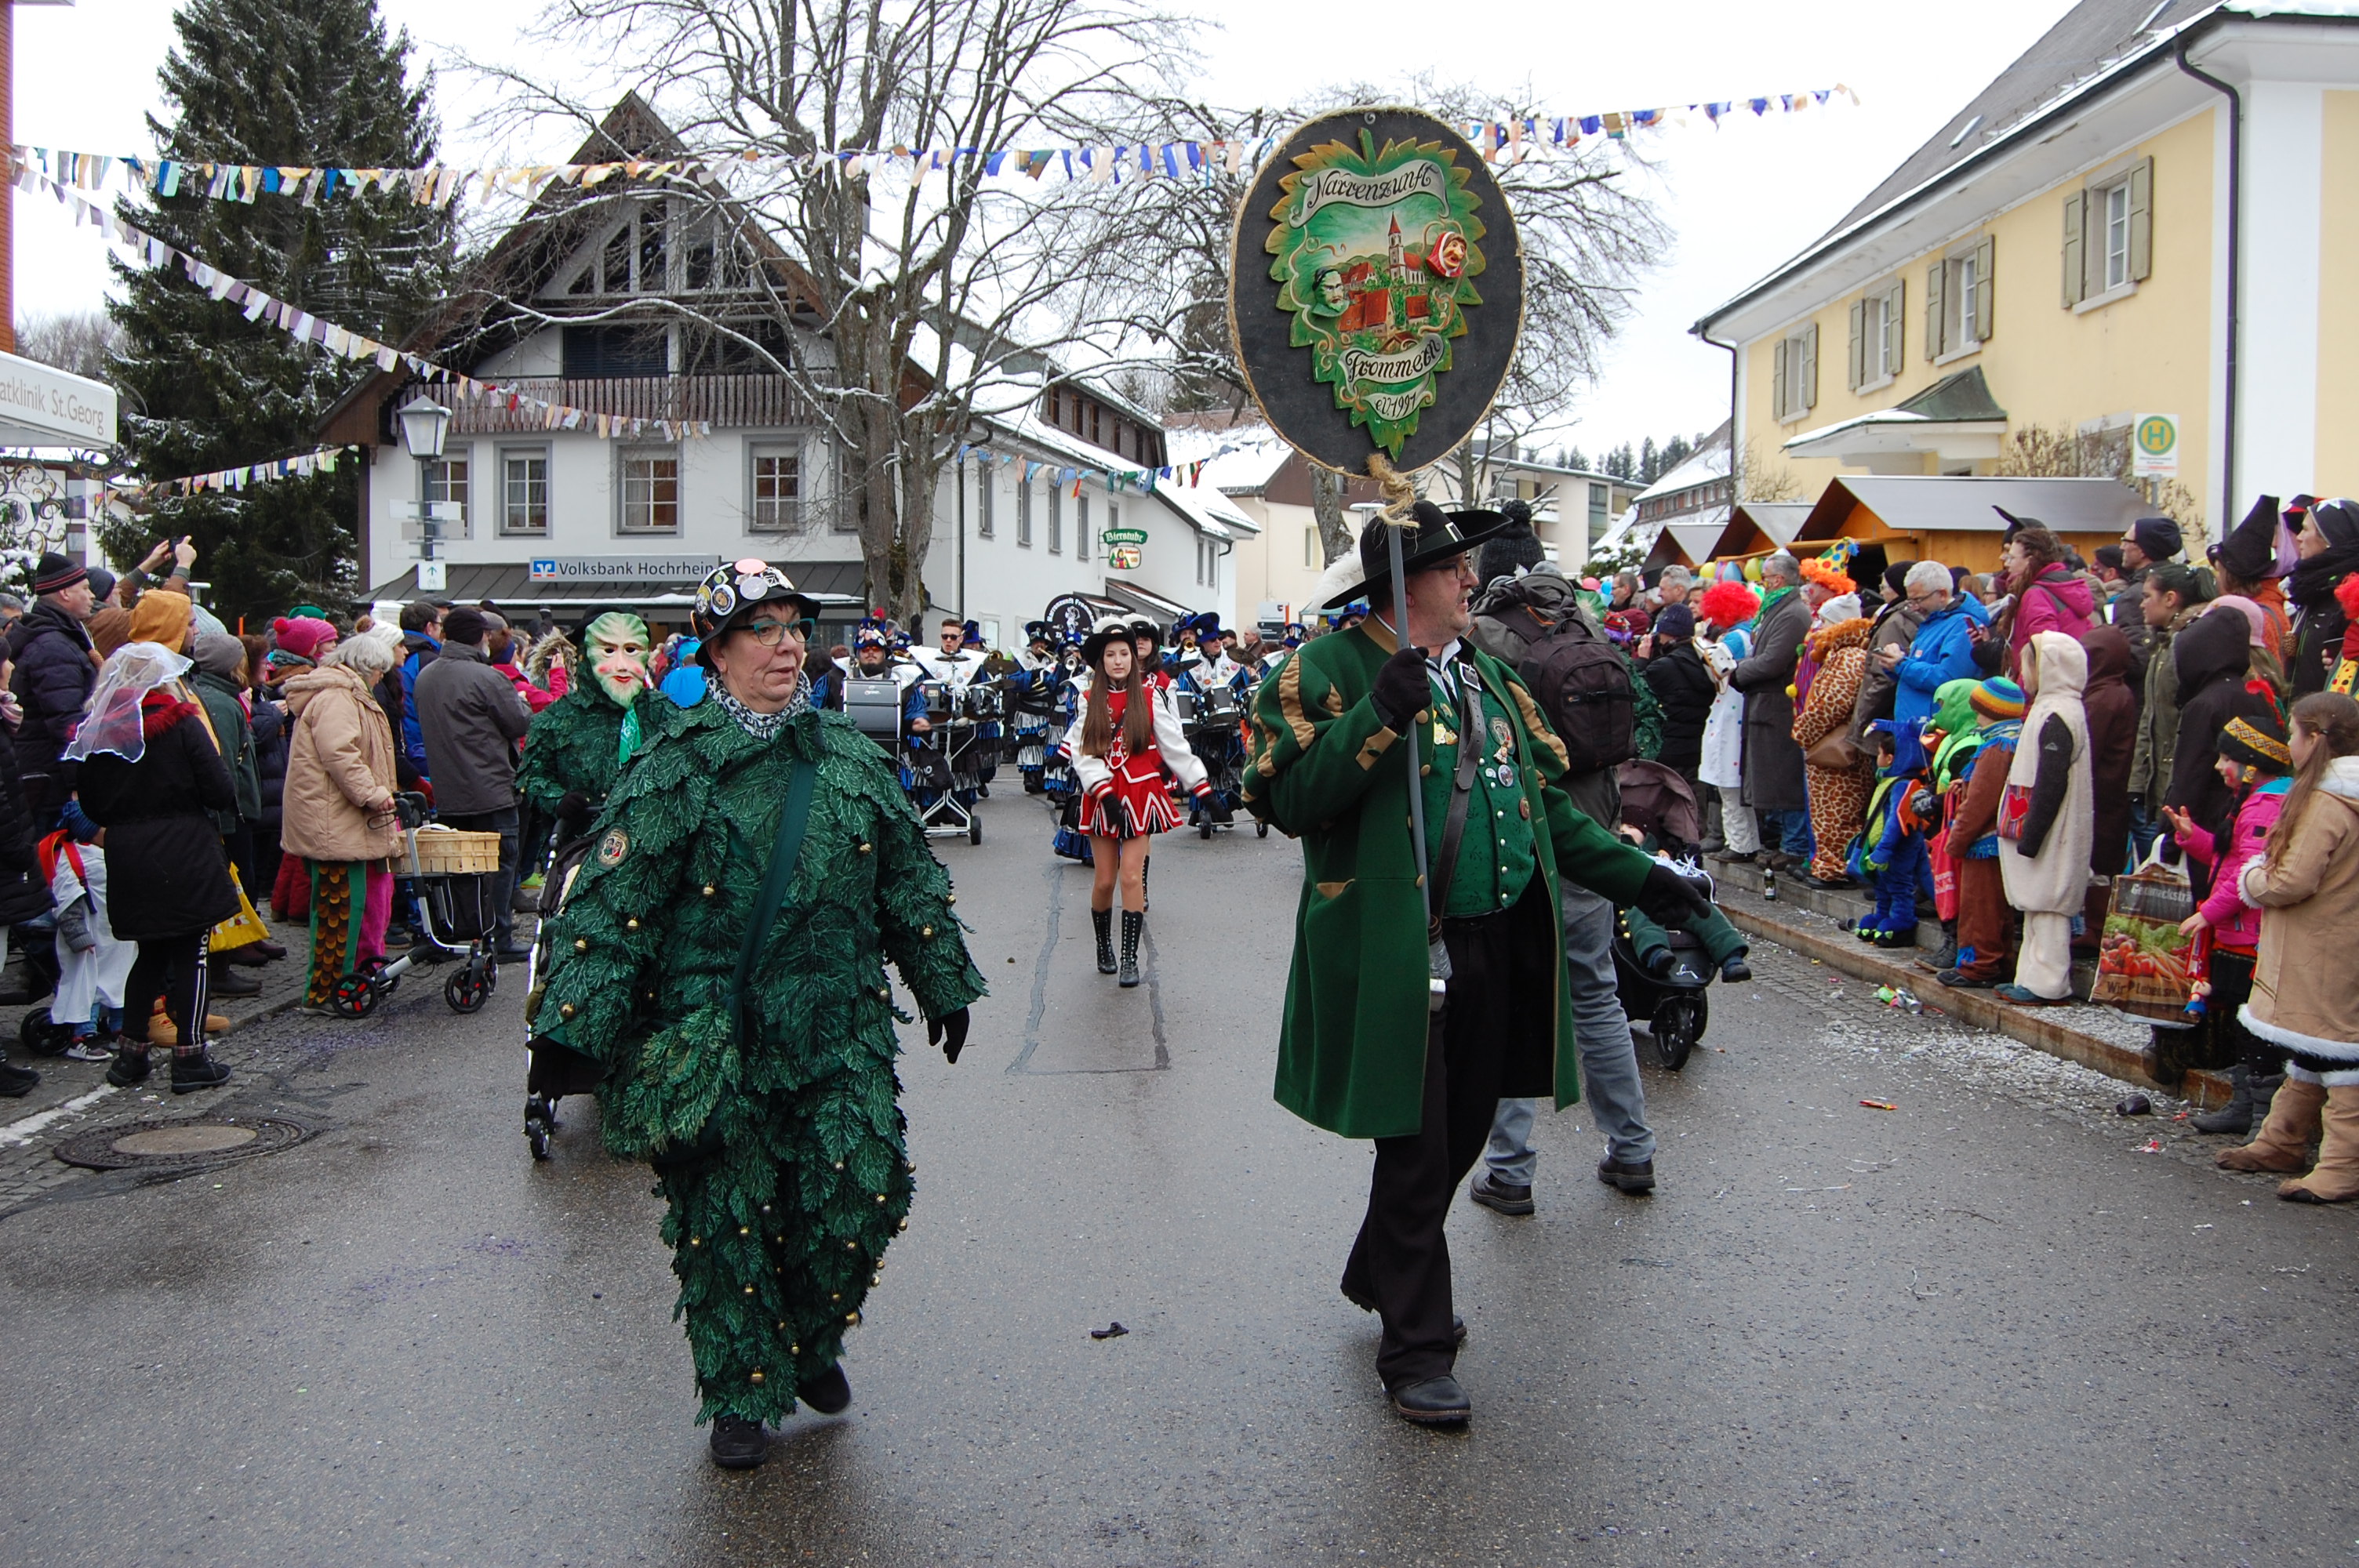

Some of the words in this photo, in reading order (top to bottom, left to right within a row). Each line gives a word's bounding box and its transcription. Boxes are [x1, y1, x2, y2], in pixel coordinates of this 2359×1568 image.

[1307, 162, 1439, 209] Narrenzunft
[1345, 339, 1441, 383] Frommern
[559, 561, 633, 575] Volksbank
[638, 561, 714, 575] Hochrhein
[198, 928, 209, 967] ORT
